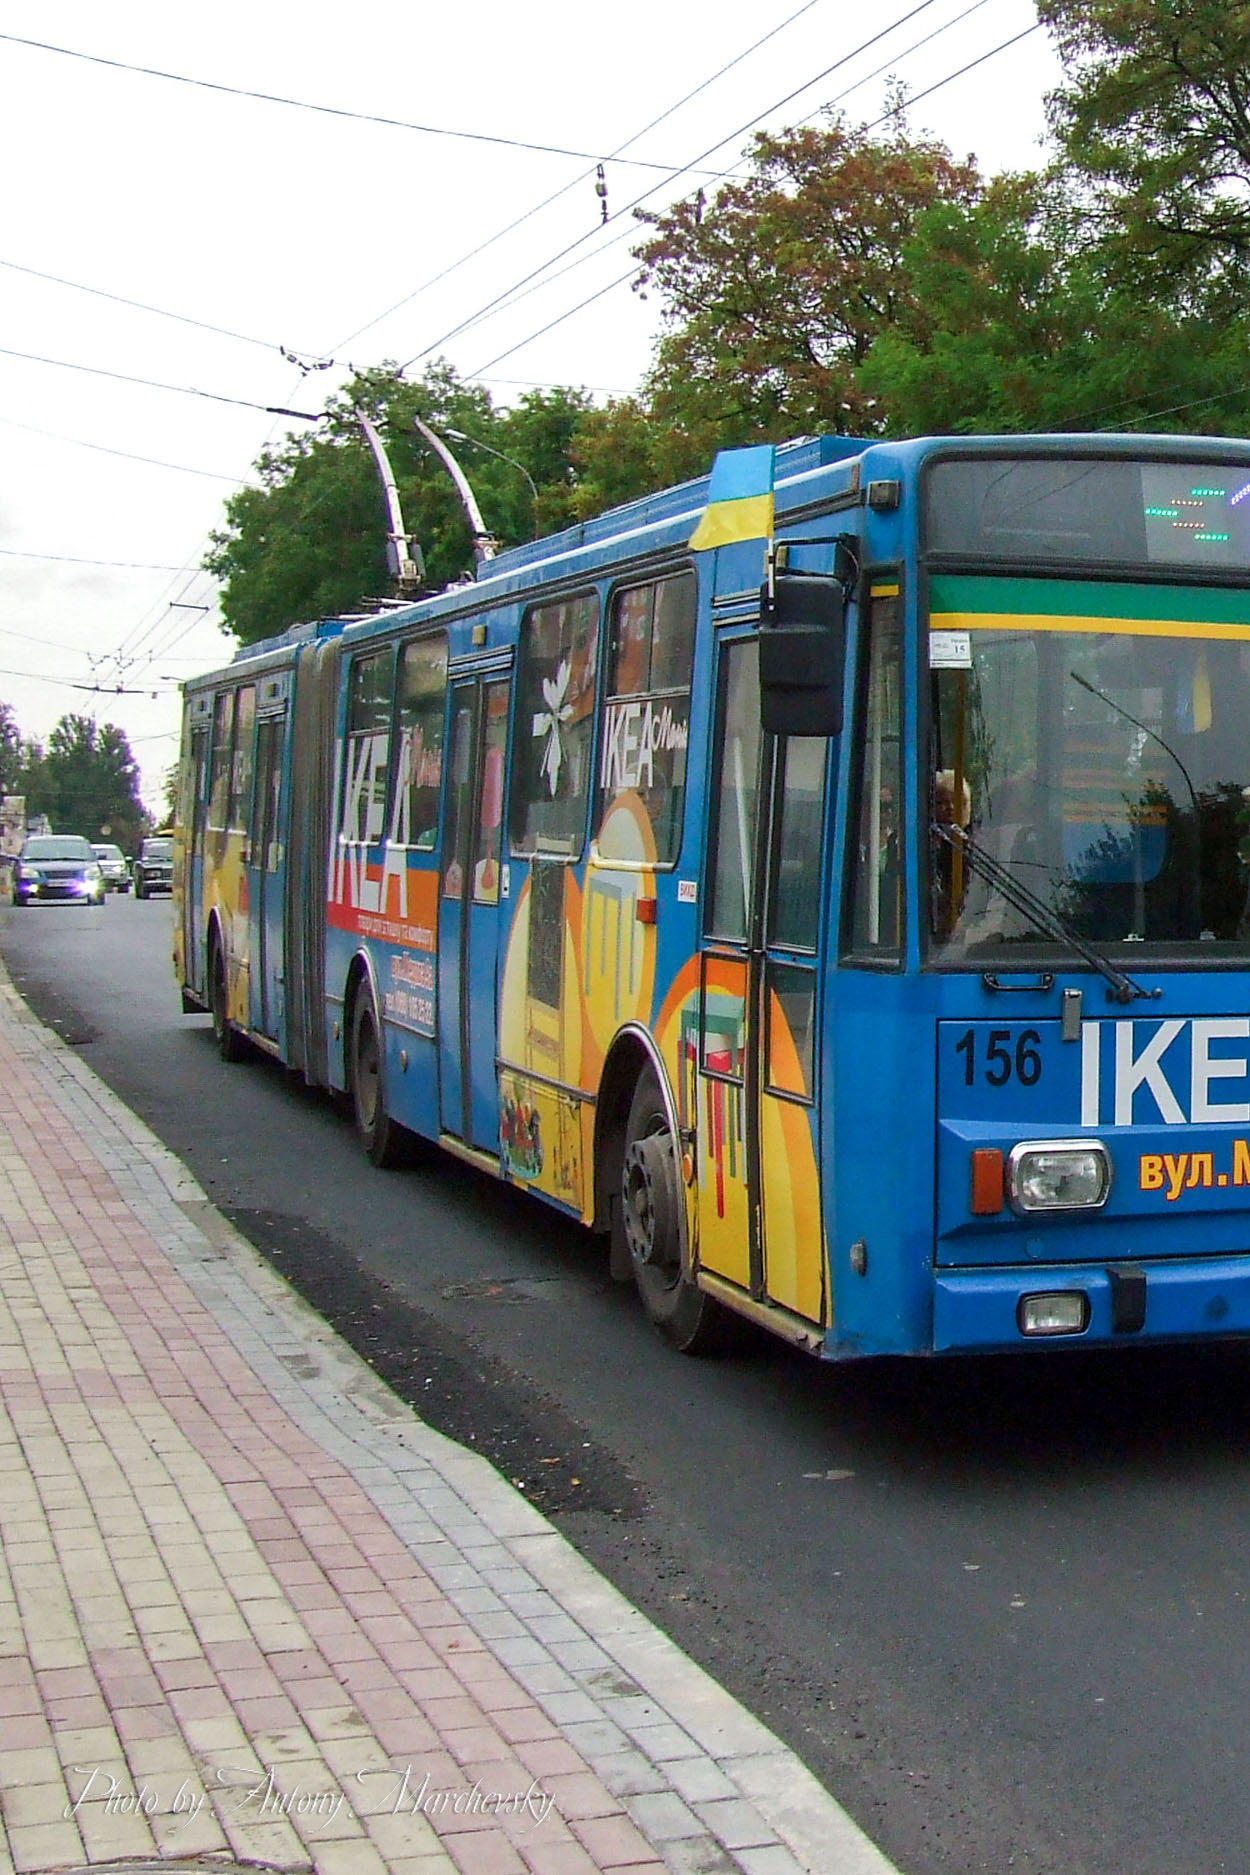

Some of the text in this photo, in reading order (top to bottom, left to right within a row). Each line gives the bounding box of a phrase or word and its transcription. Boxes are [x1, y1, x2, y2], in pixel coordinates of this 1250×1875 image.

[601, 701, 653, 789] IKEA
[327, 732, 409, 919] IKEA
[955, 1029, 1041, 1087] 156
